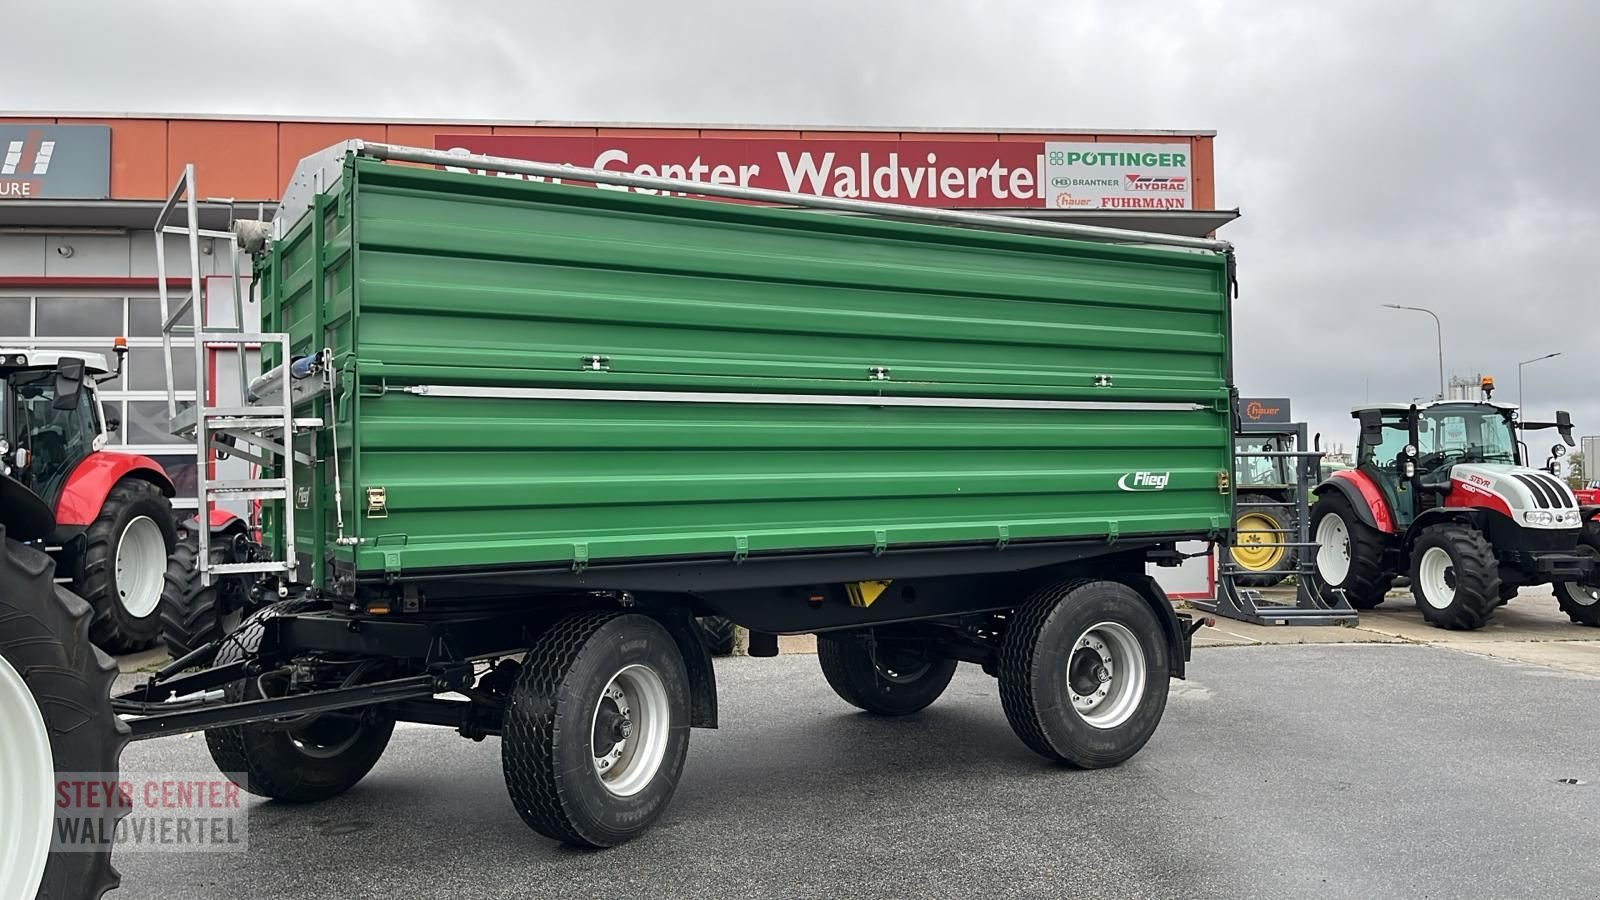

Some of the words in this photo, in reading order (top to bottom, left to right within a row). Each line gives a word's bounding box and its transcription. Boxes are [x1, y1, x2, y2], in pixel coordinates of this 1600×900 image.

[1067, 152, 1186, 167] PÖTTINGER
[776, 151, 1046, 199] Waldviertel
[1072, 179, 1119, 187] BRANTNER
[1135, 182, 1185, 191] HYDRAC
[1061, 196, 1091, 206] hauer
[1101, 197, 1185, 208] FUHRMANN
[1134, 471, 1170, 489] Fliegl
[1468, 474, 1491, 488] STEYR
